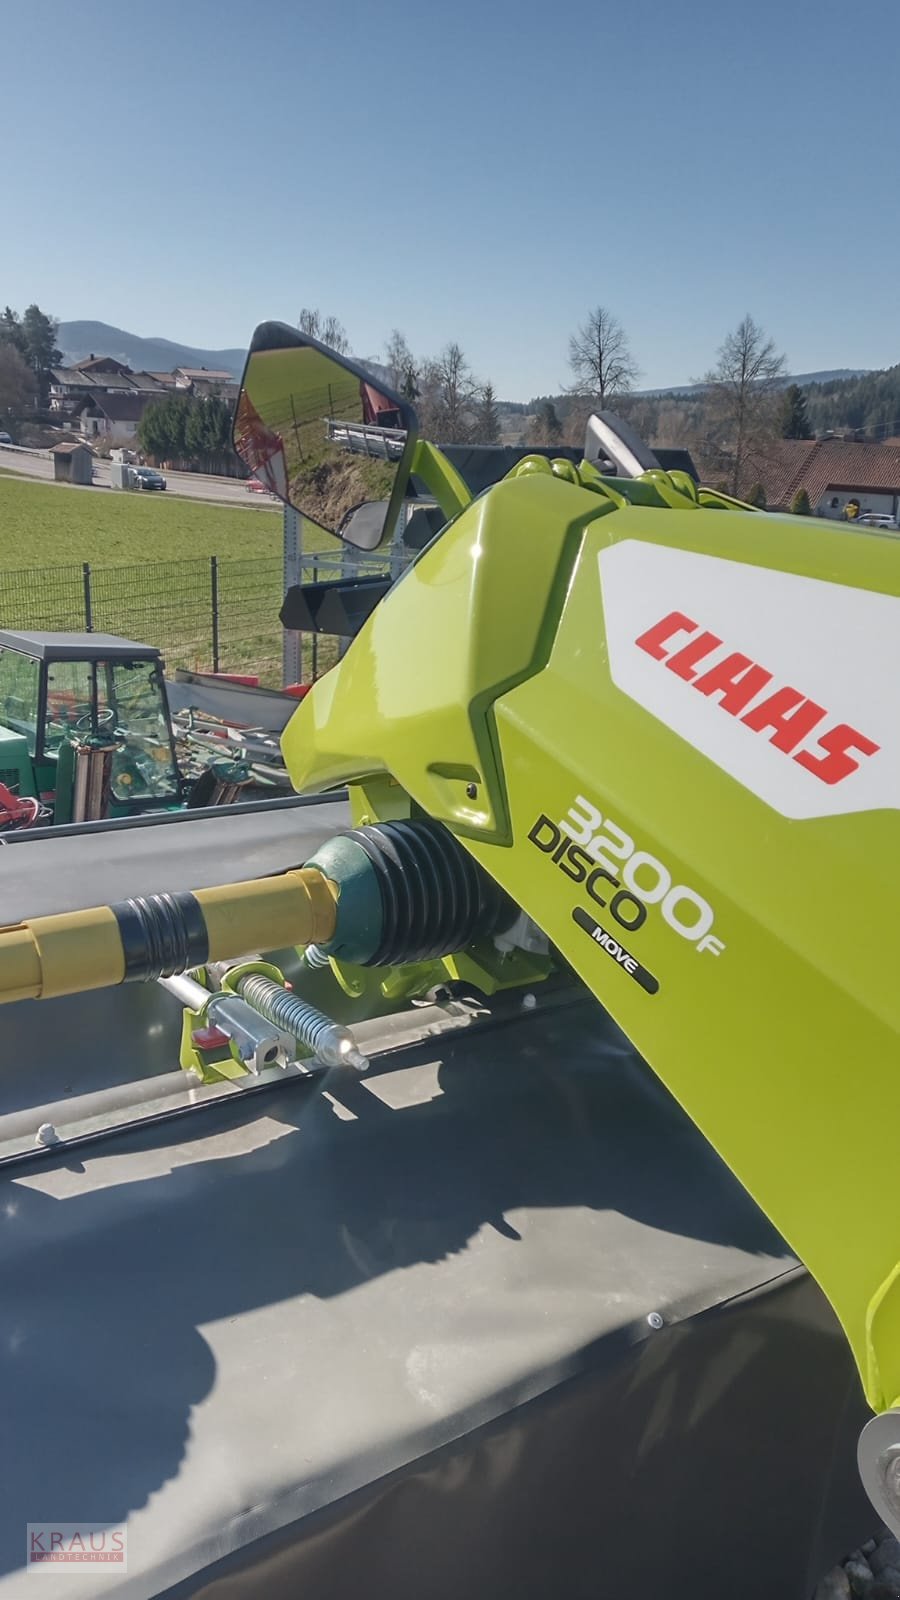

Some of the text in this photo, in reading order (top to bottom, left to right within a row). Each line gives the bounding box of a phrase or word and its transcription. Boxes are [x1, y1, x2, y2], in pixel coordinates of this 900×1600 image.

[635, 611, 881, 785] CLAAS
[527, 814, 647, 932] DISCO
[591, 927, 638, 974] MOVE
